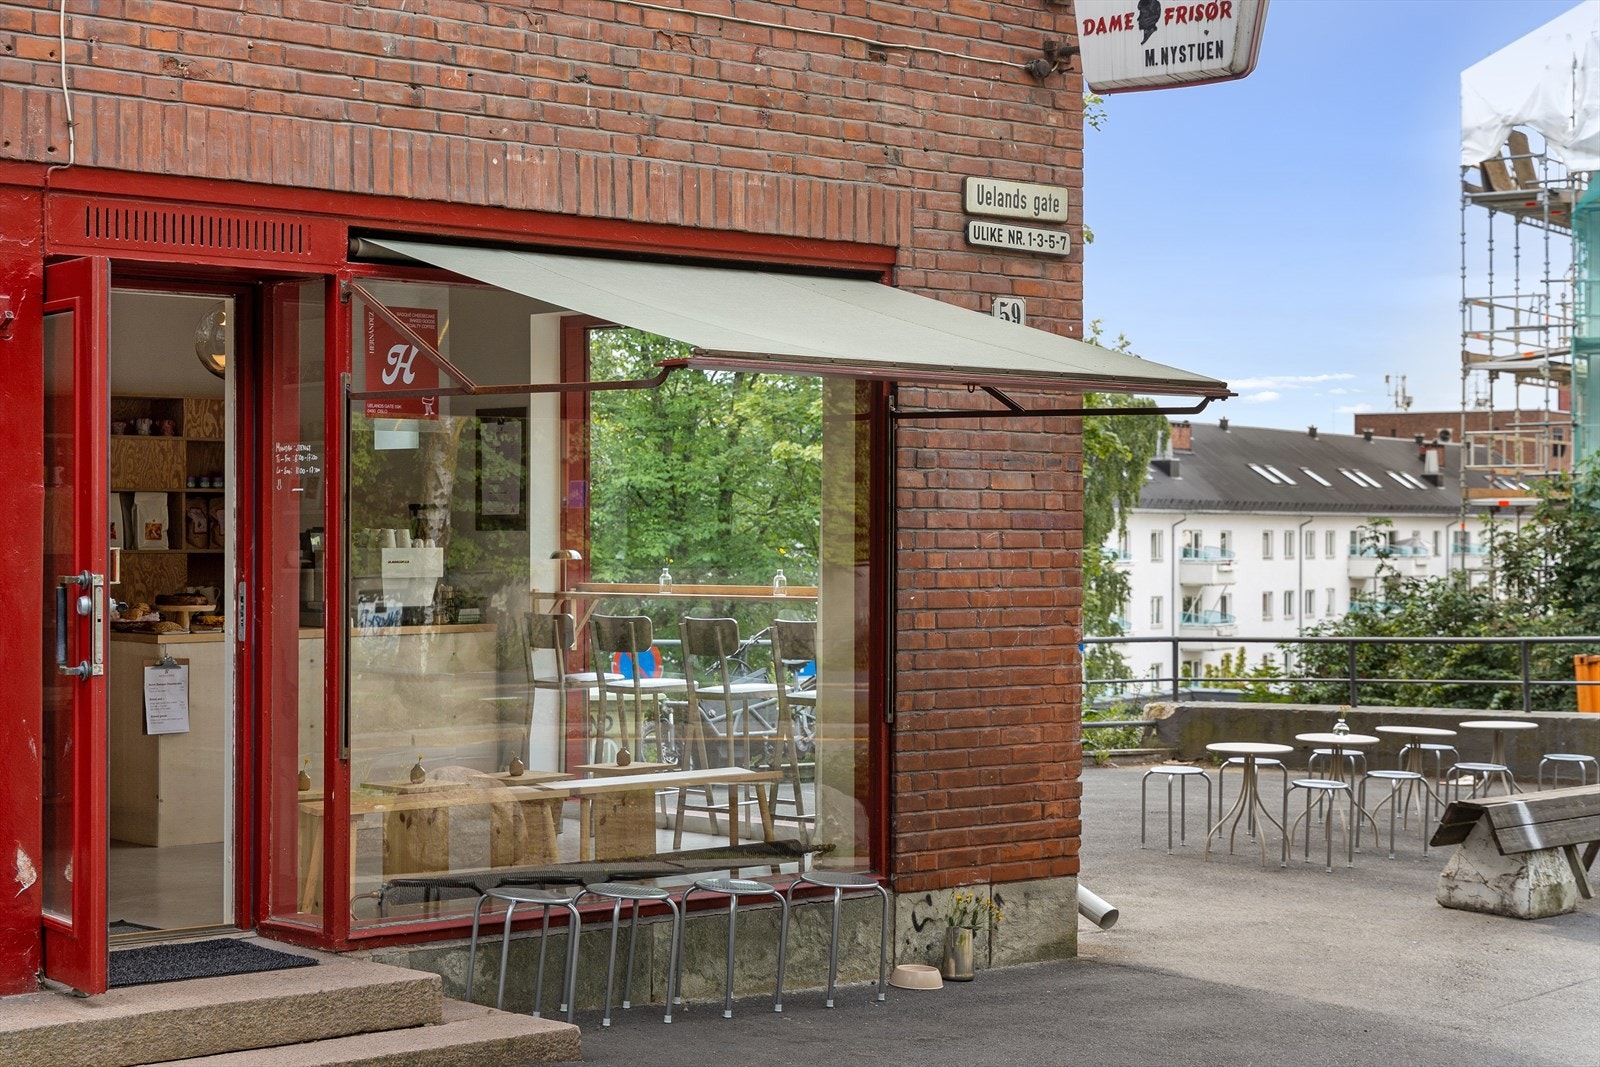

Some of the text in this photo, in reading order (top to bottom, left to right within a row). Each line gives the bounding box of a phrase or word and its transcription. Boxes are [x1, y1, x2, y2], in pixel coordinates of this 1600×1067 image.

[1082, 1, 1233, 36] DAME FRISØR
[977, 184, 1060, 217] Uelands gate
[973, 225, 1003, 243] ULIKE
[1000, 301, 1021, 324] 59
[382, 344, 419, 385] H
